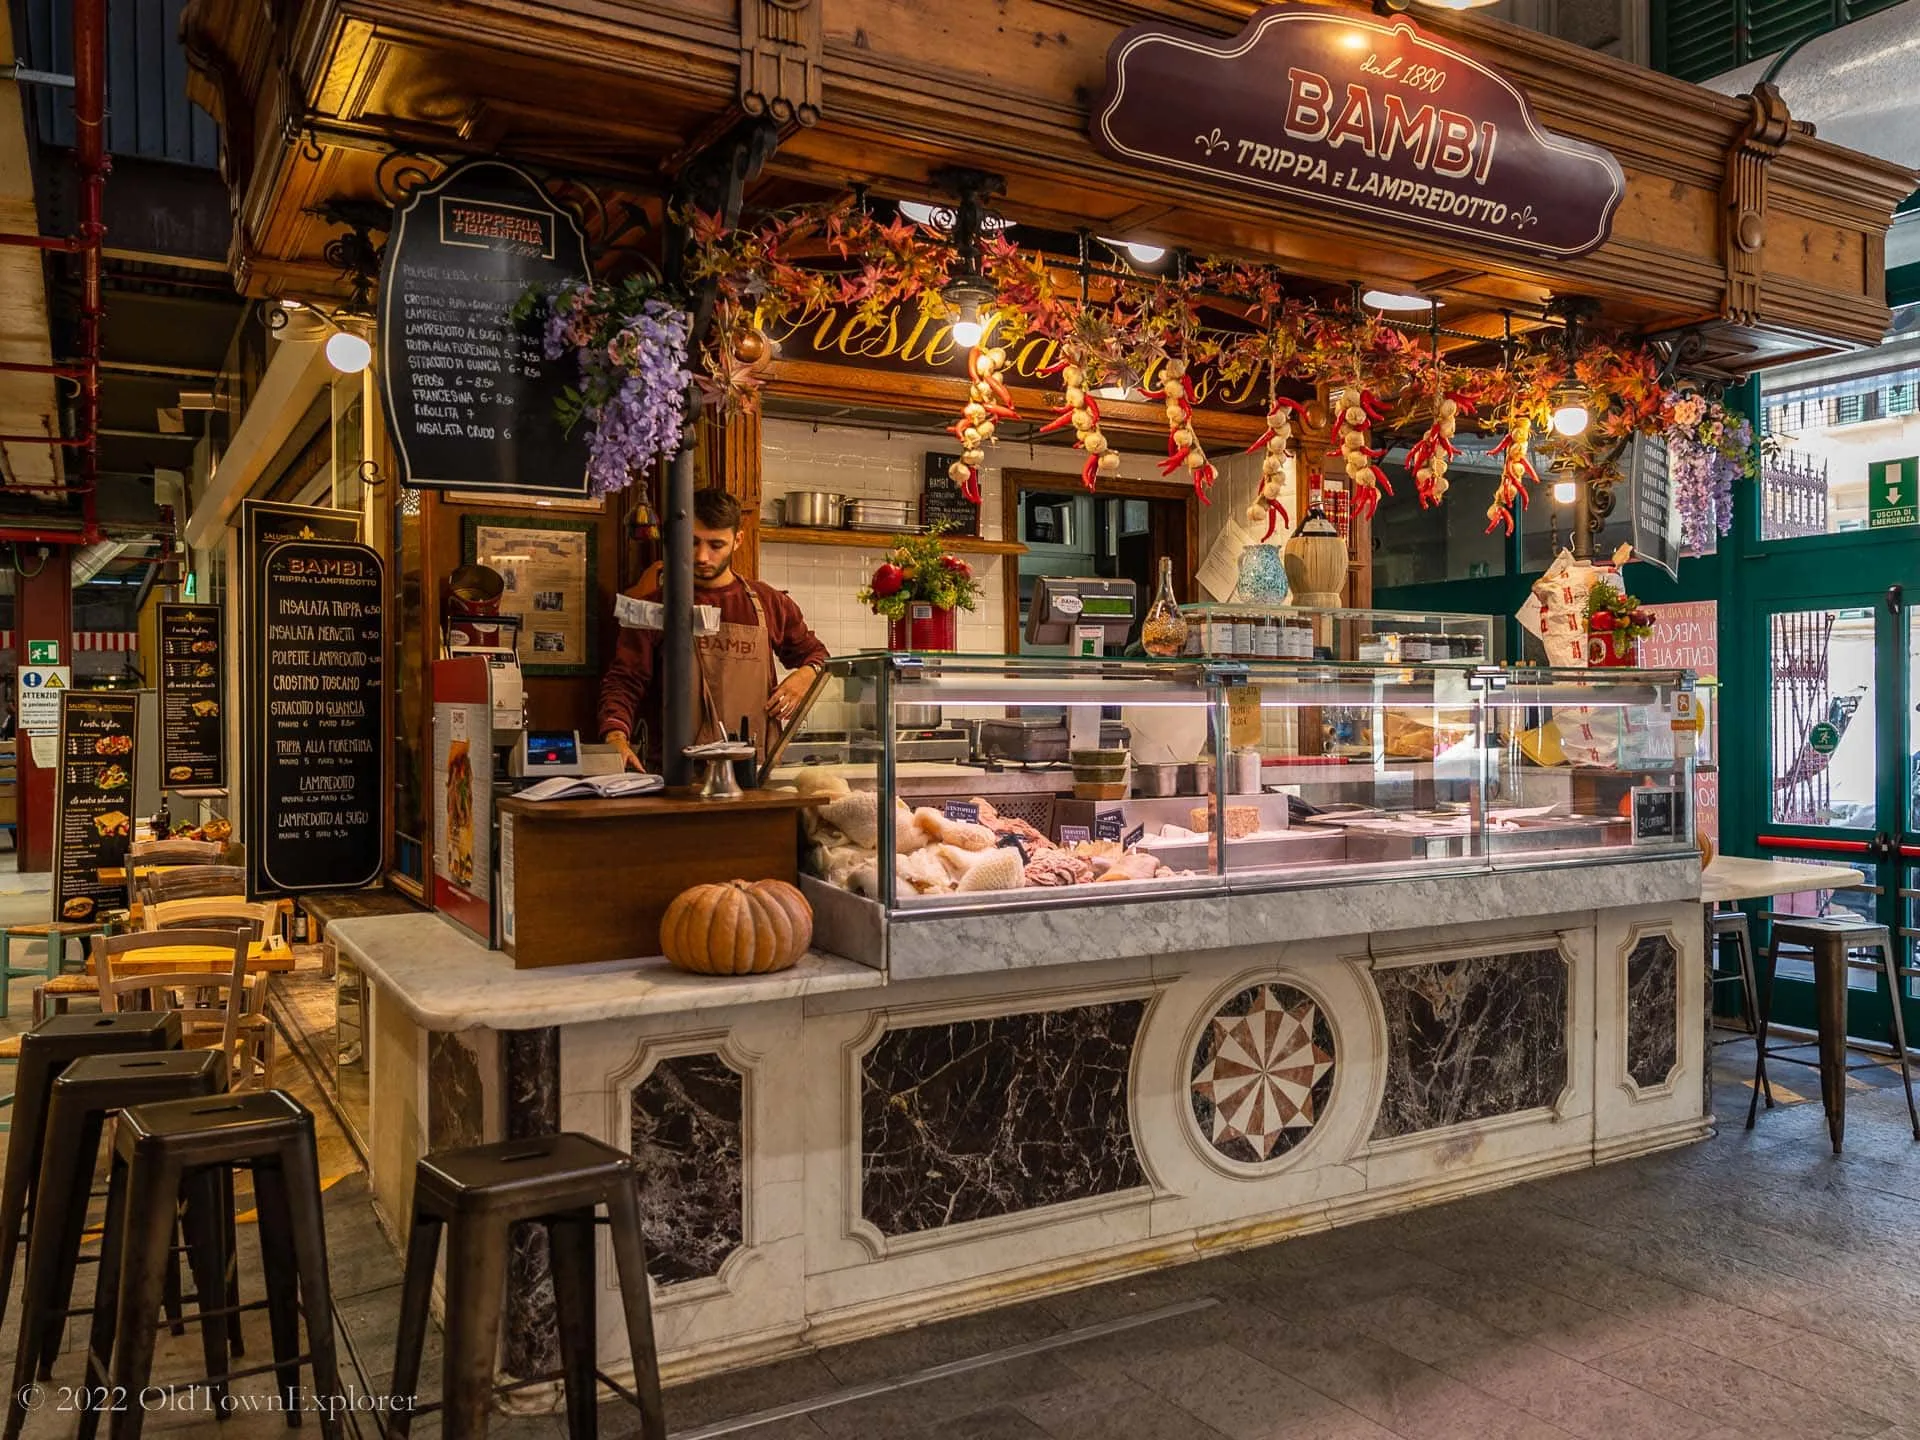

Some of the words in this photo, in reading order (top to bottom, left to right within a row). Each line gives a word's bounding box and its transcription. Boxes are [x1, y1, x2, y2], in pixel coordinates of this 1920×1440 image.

[1360, 54, 1402, 79] dal
[1400, 65, 1447, 94] 1890
[1284, 68, 1496, 185] BAMBI
[1237, 139, 1327, 184] TRIPPA
[1332, 171, 1344, 188] E
[1347, 167, 1507, 224] LAMPREDOTTO
[452, 208, 542, 233] TRIPPERIA
[412, 390, 474, 404] FRANCESINA
[416, 422, 464, 436] INSALATA
[1872, 515, 1916, 526] EMERGENZA
[1876, 510, 1902, 519] USCITA
[1904, 508, 1911, 516] DI
[288, 557, 364, 577] BAMBI
[273, 575, 307, 584] TRIPPA
[314, 576, 377, 587] LAMPREDOTTO
[280, 599, 329, 616] INSALATA
[332, 600, 362, 617] TRIPPA
[270, 625, 314, 641] INSALATA
[698, 636, 756, 654] BAMBI
[272, 650, 310, 666] POLPETTE
[273, 675, 319, 691] CROSTINO
[322, 676, 360, 691] TOSCANO
[326, 701, 365, 716] GUANCIA
[276, 739, 301, 753] TRIPPA
[305, 739, 325, 753] ALLA
[278, 811, 333, 828] LAMPREDOTTO
